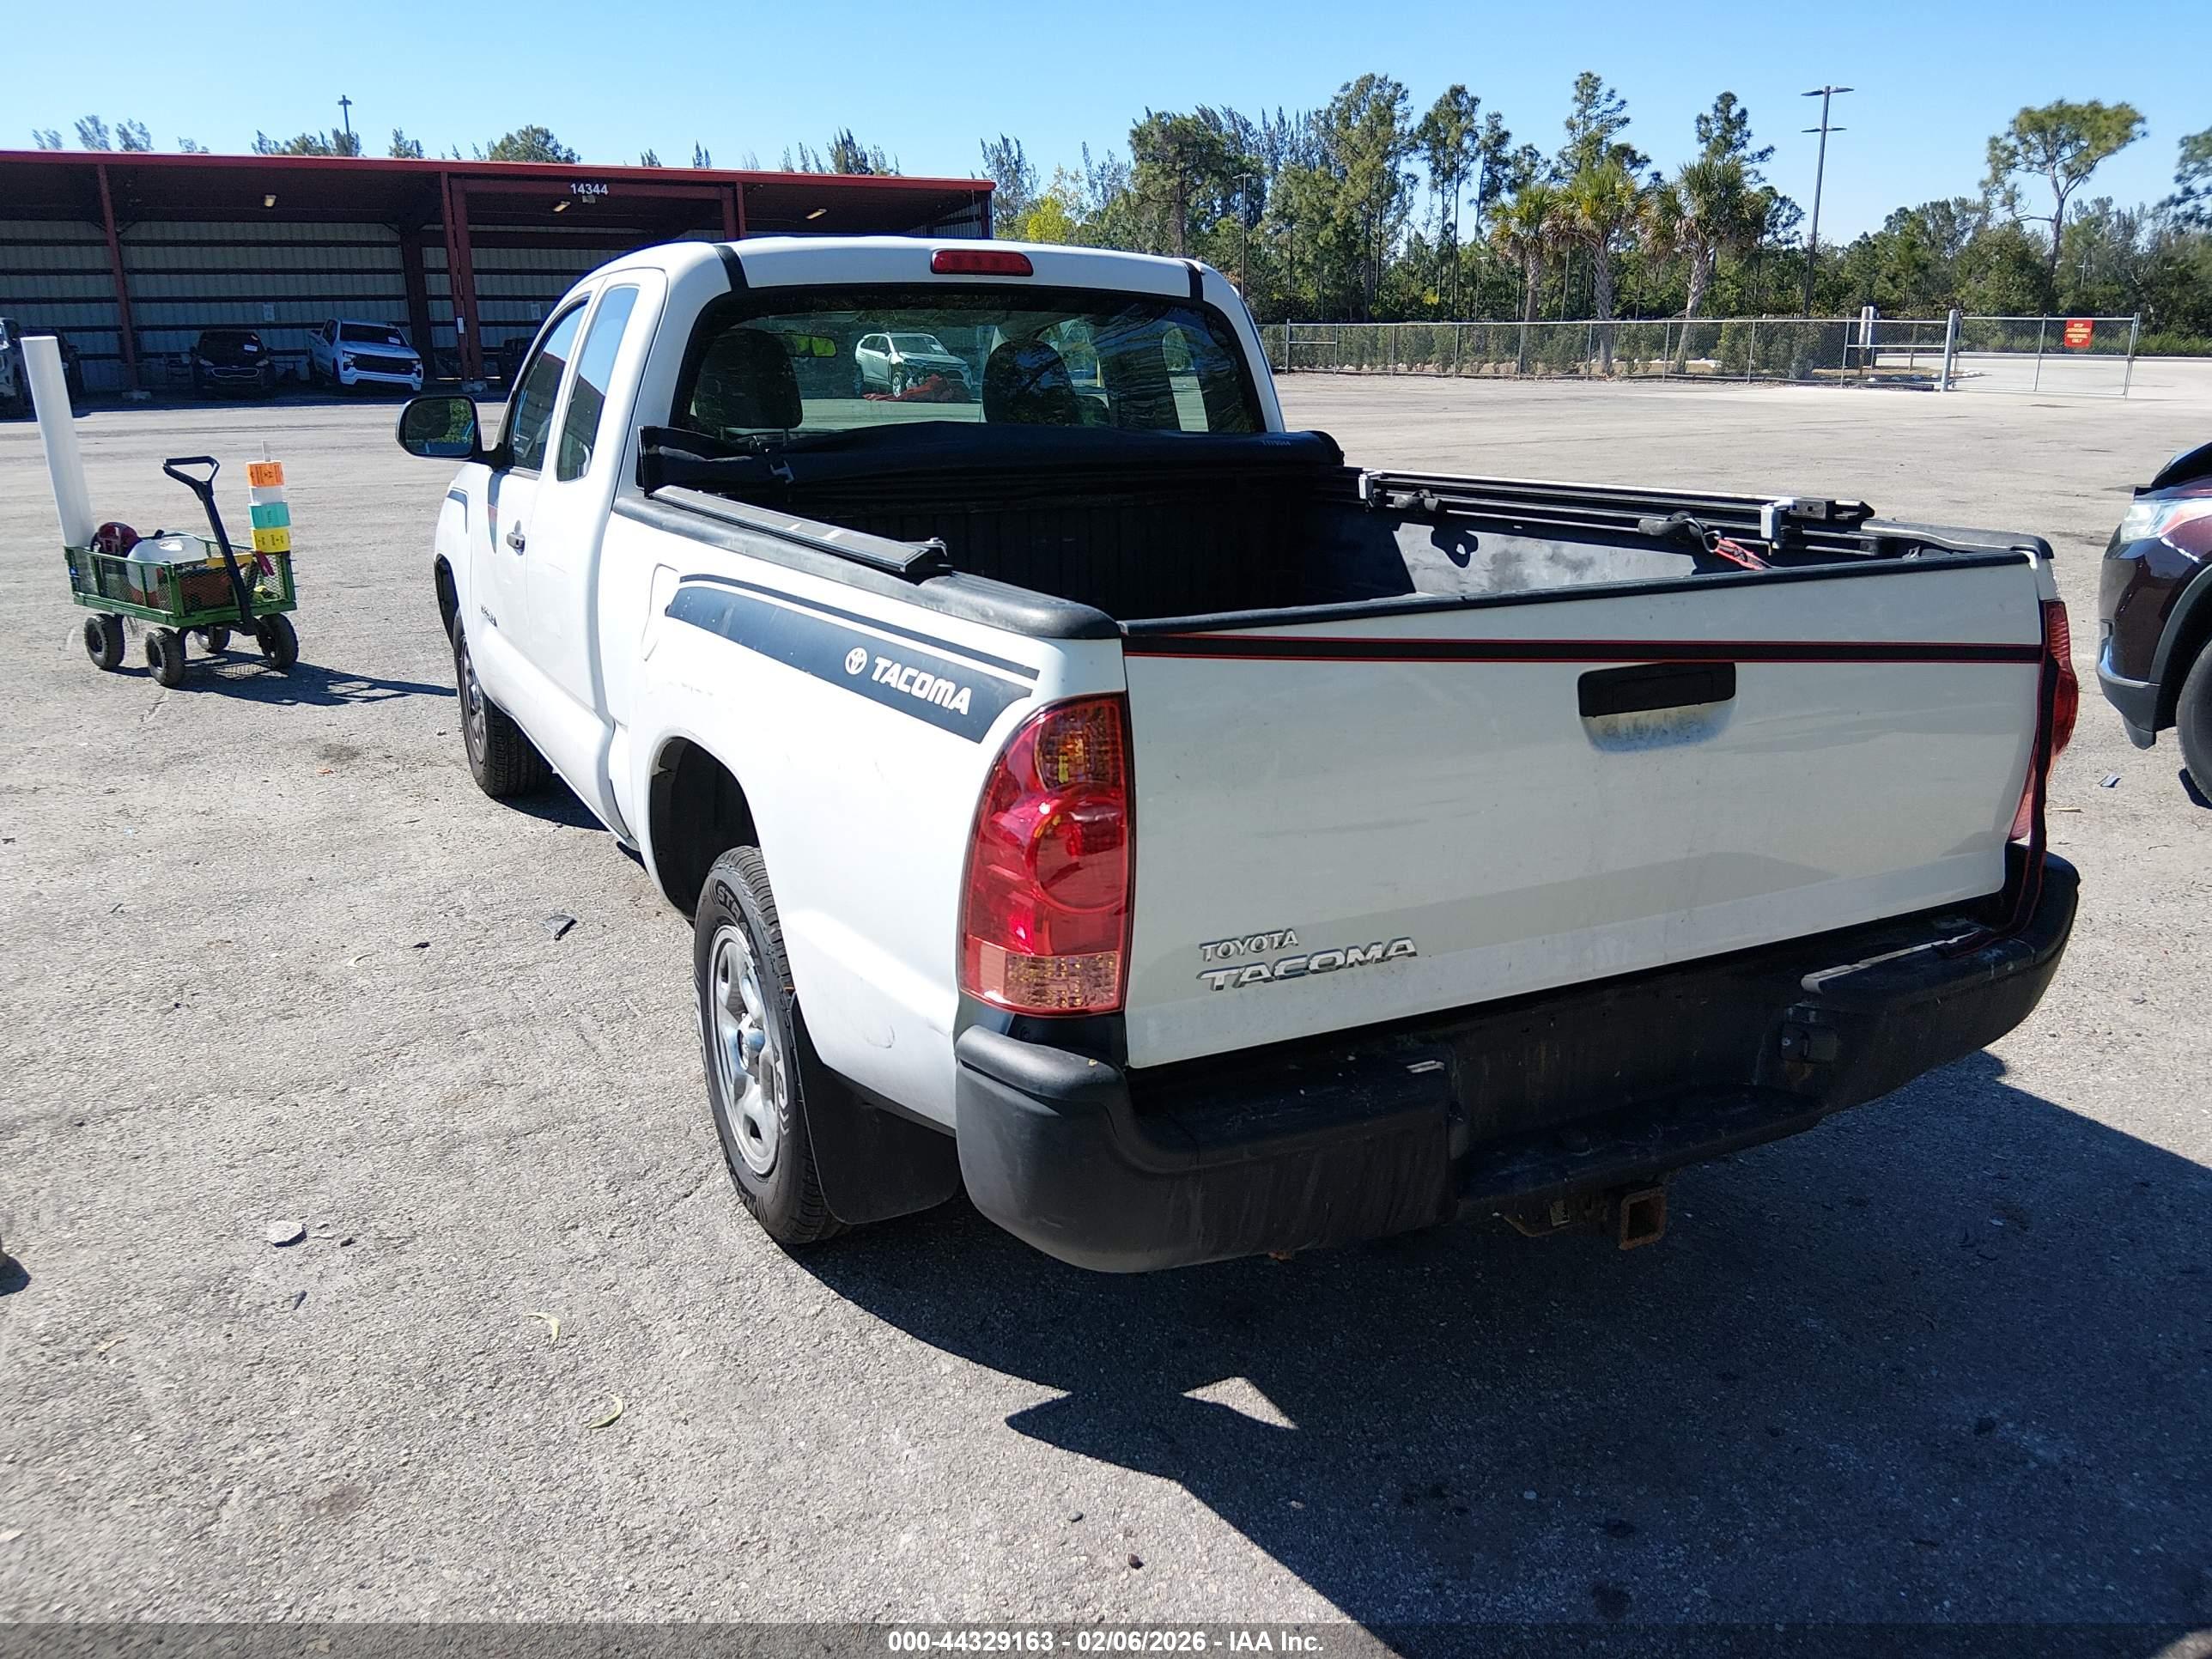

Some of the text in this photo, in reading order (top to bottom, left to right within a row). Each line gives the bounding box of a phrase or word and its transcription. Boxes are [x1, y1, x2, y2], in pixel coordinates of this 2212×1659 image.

[570, 183, 609, 195] 14344
[871, 656, 972, 715] TACOMA
[1195, 937, 1418, 991] TACOMA
[1199, 928, 1299, 962] TOYOTA
